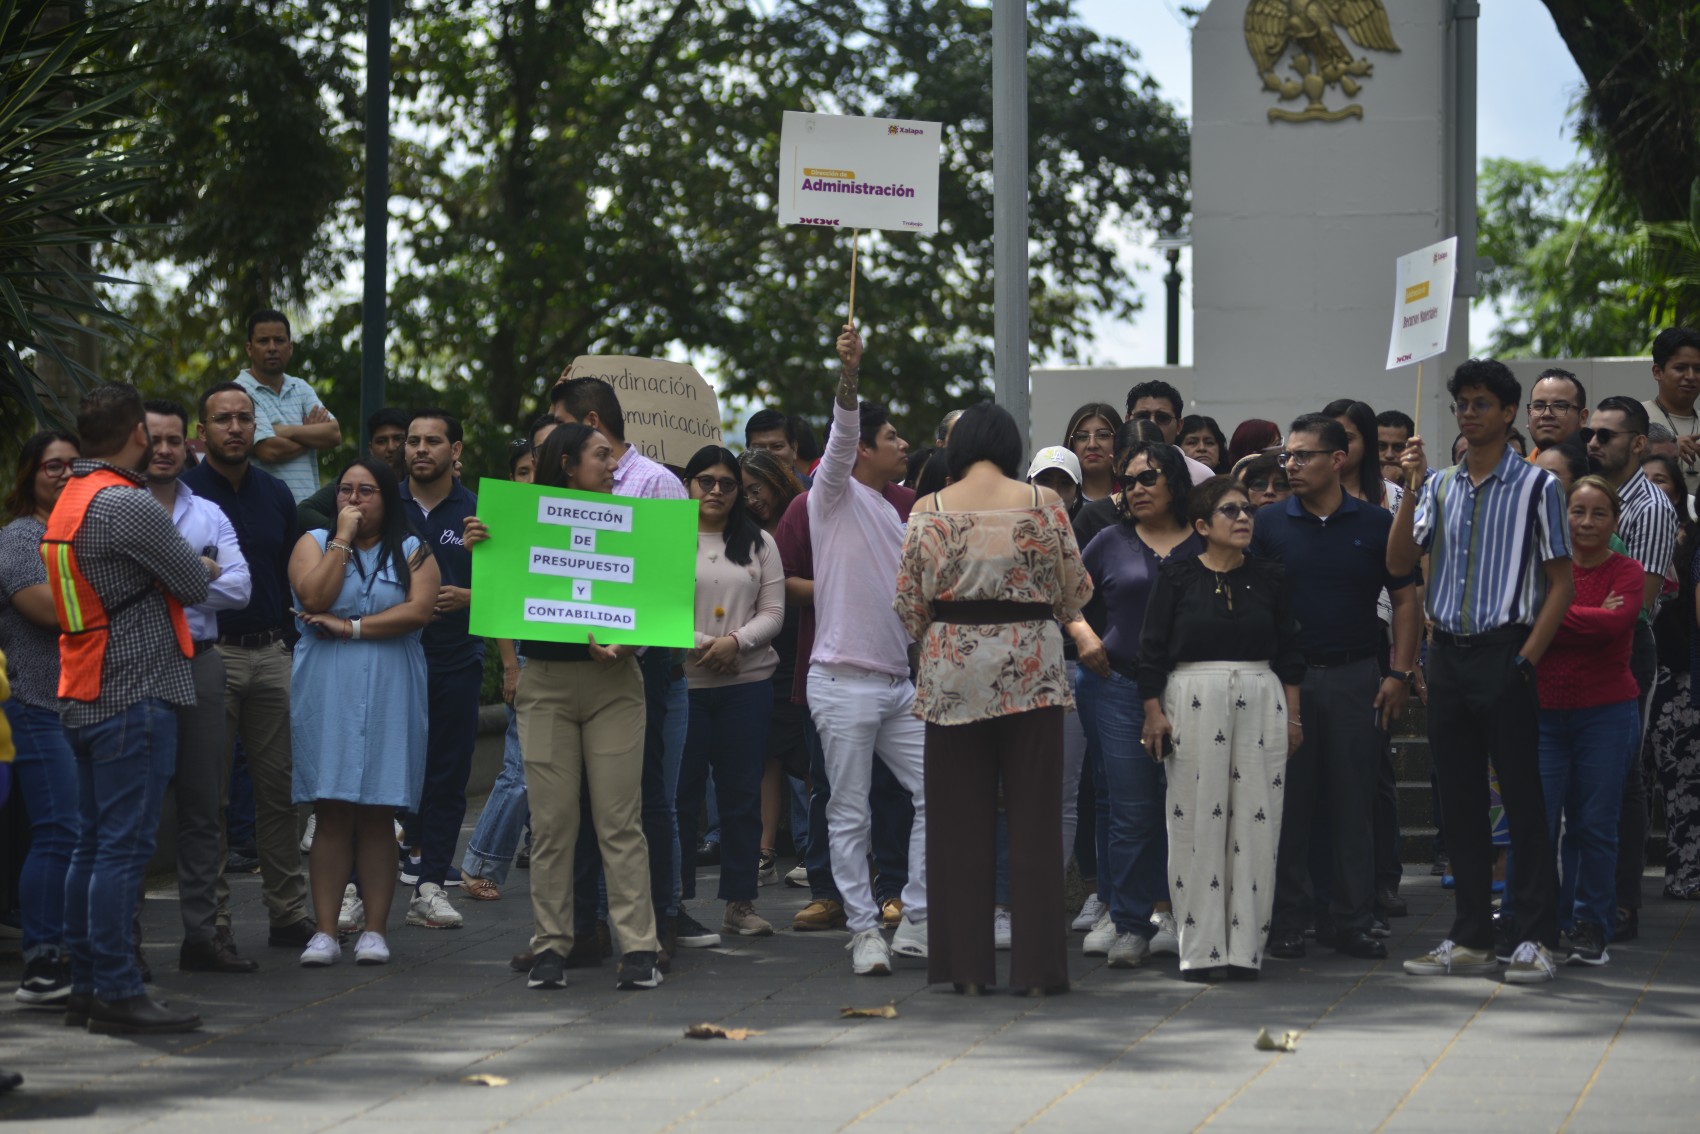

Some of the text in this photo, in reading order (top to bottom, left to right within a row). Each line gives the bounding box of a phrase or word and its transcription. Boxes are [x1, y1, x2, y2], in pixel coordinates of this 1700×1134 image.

[899, 127, 923, 135] Xalapa
[801, 178, 915, 198] Administración
[621, 410, 722, 441] omunicación
[547, 505, 623, 524] DIRECCIÓN
[574, 535, 592, 546] DE
[533, 554, 630, 574] PRESUPUESTO
[576, 586, 585, 595] Y
[527, 606, 632, 624] CONTABILIDAD
